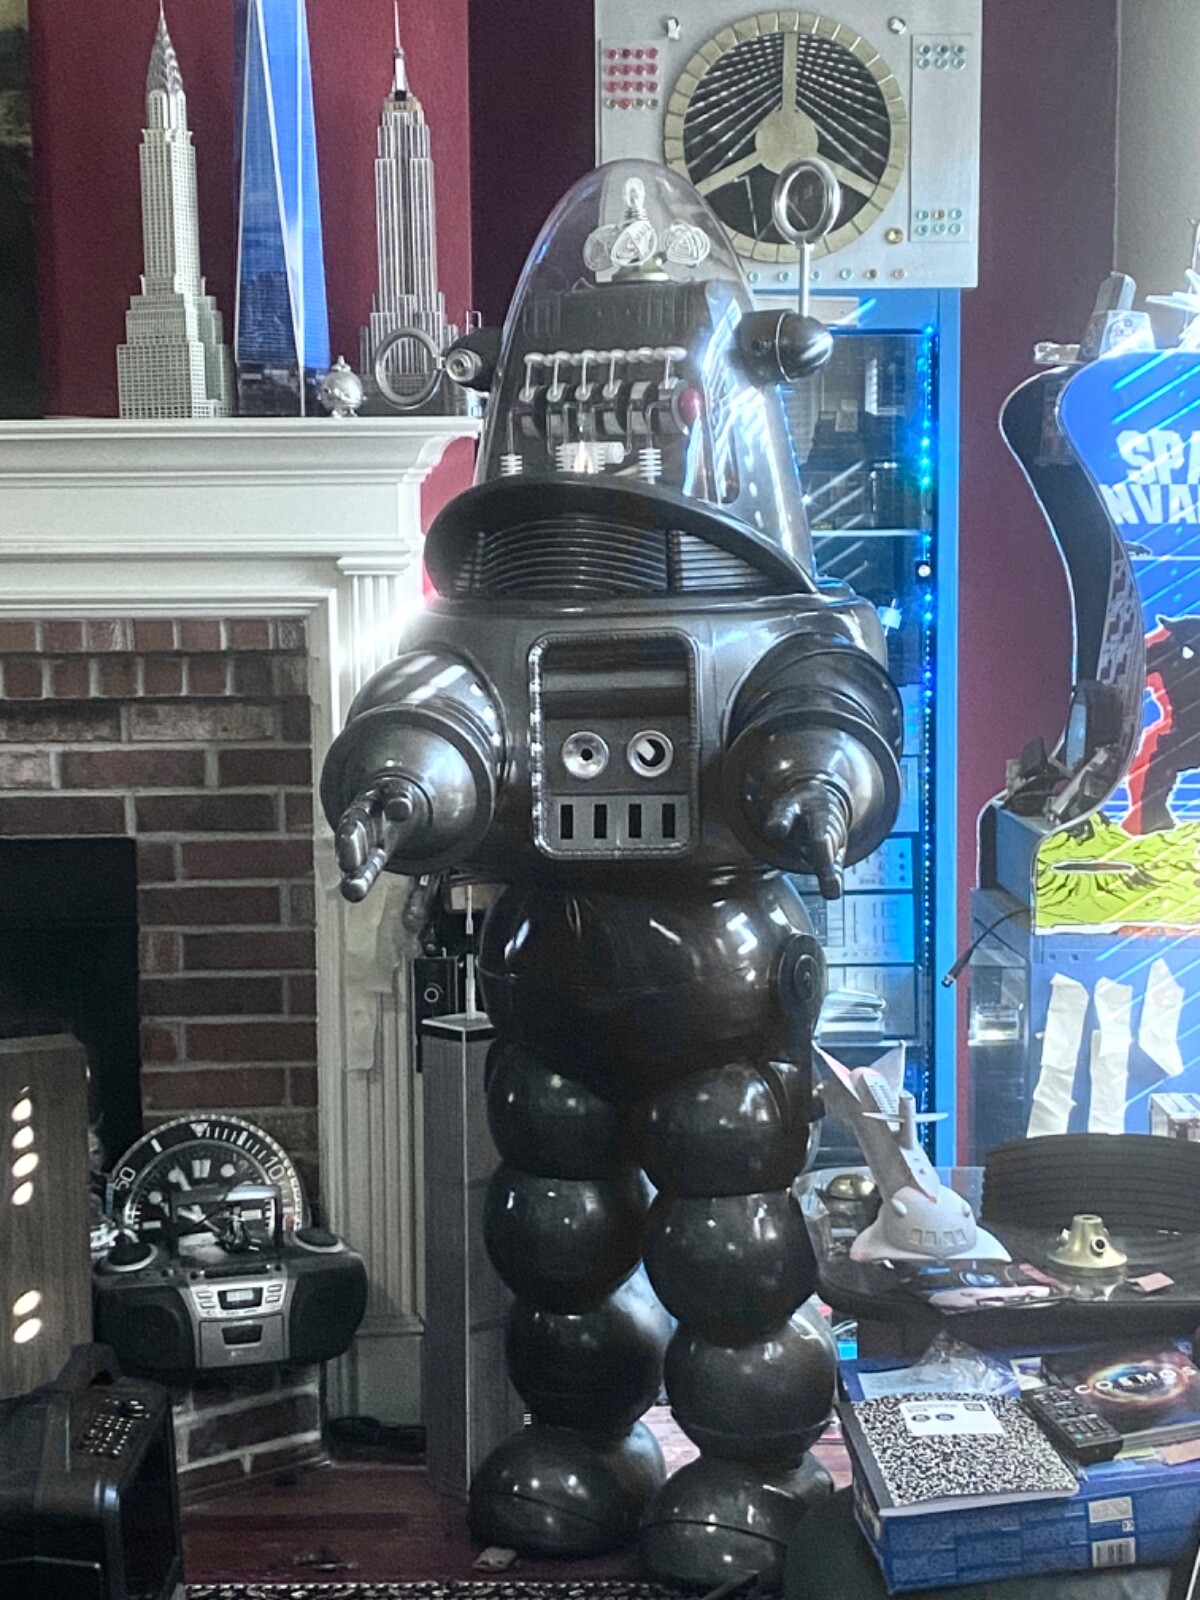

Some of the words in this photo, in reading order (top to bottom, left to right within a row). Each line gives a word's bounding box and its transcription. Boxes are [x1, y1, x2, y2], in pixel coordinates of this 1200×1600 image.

[1098, 483, 1200, 525] NVA
[114, 1166, 136, 1191] 50
[264, 1155, 286, 1181] 10
